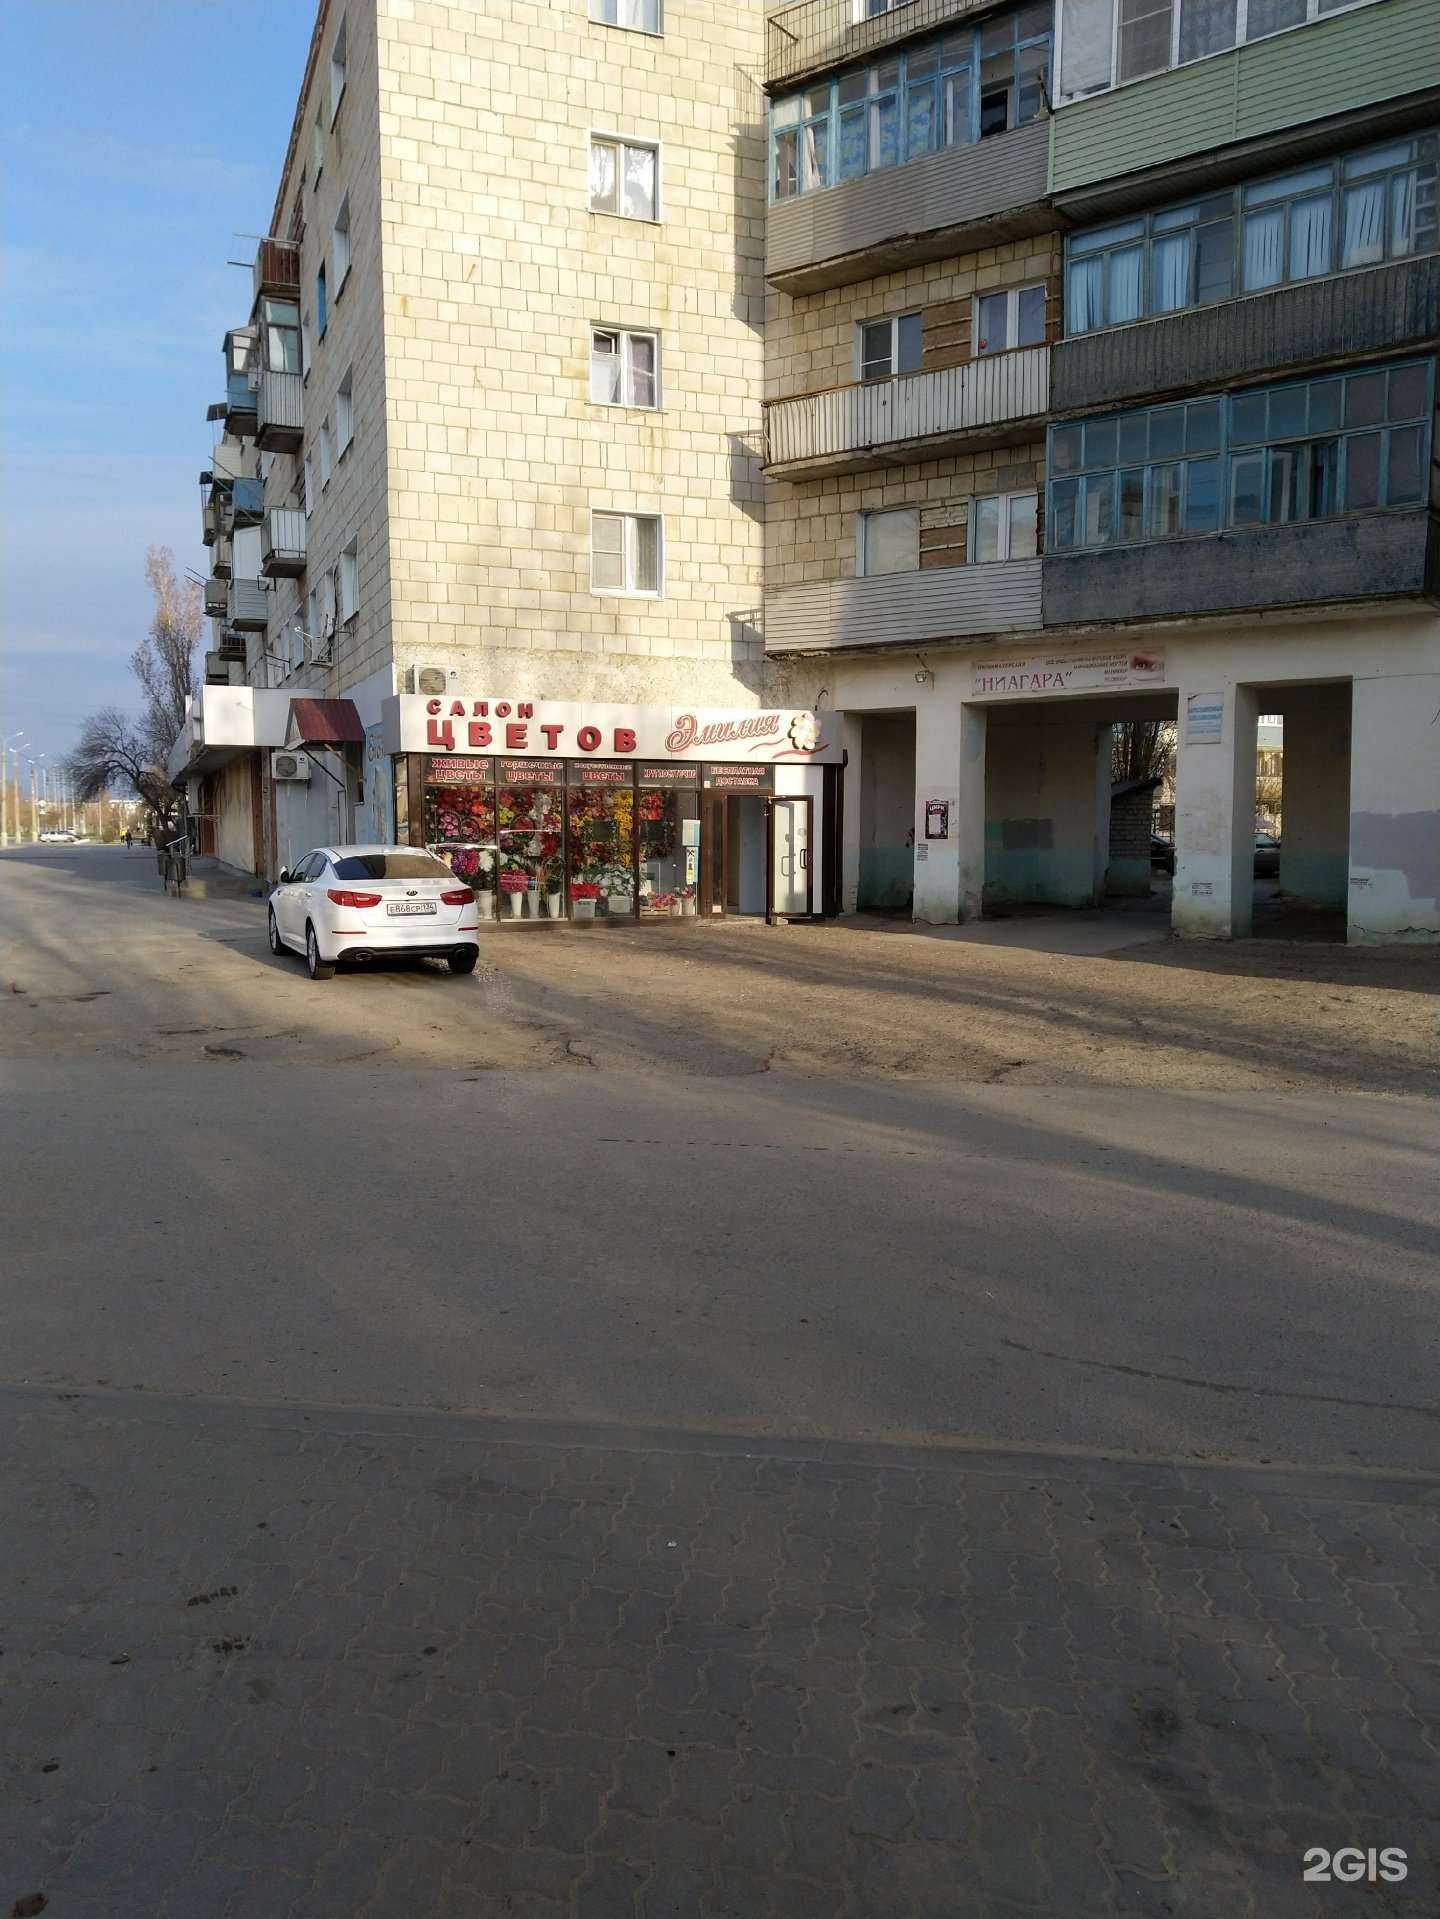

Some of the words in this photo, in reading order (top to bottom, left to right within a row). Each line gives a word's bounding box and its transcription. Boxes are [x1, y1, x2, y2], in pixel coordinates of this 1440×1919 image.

[426, 698, 534, 719] САЛОН
[426, 719, 637, 753] ЦВЕТОВ
[665, 713, 780, 752] Эмилия
